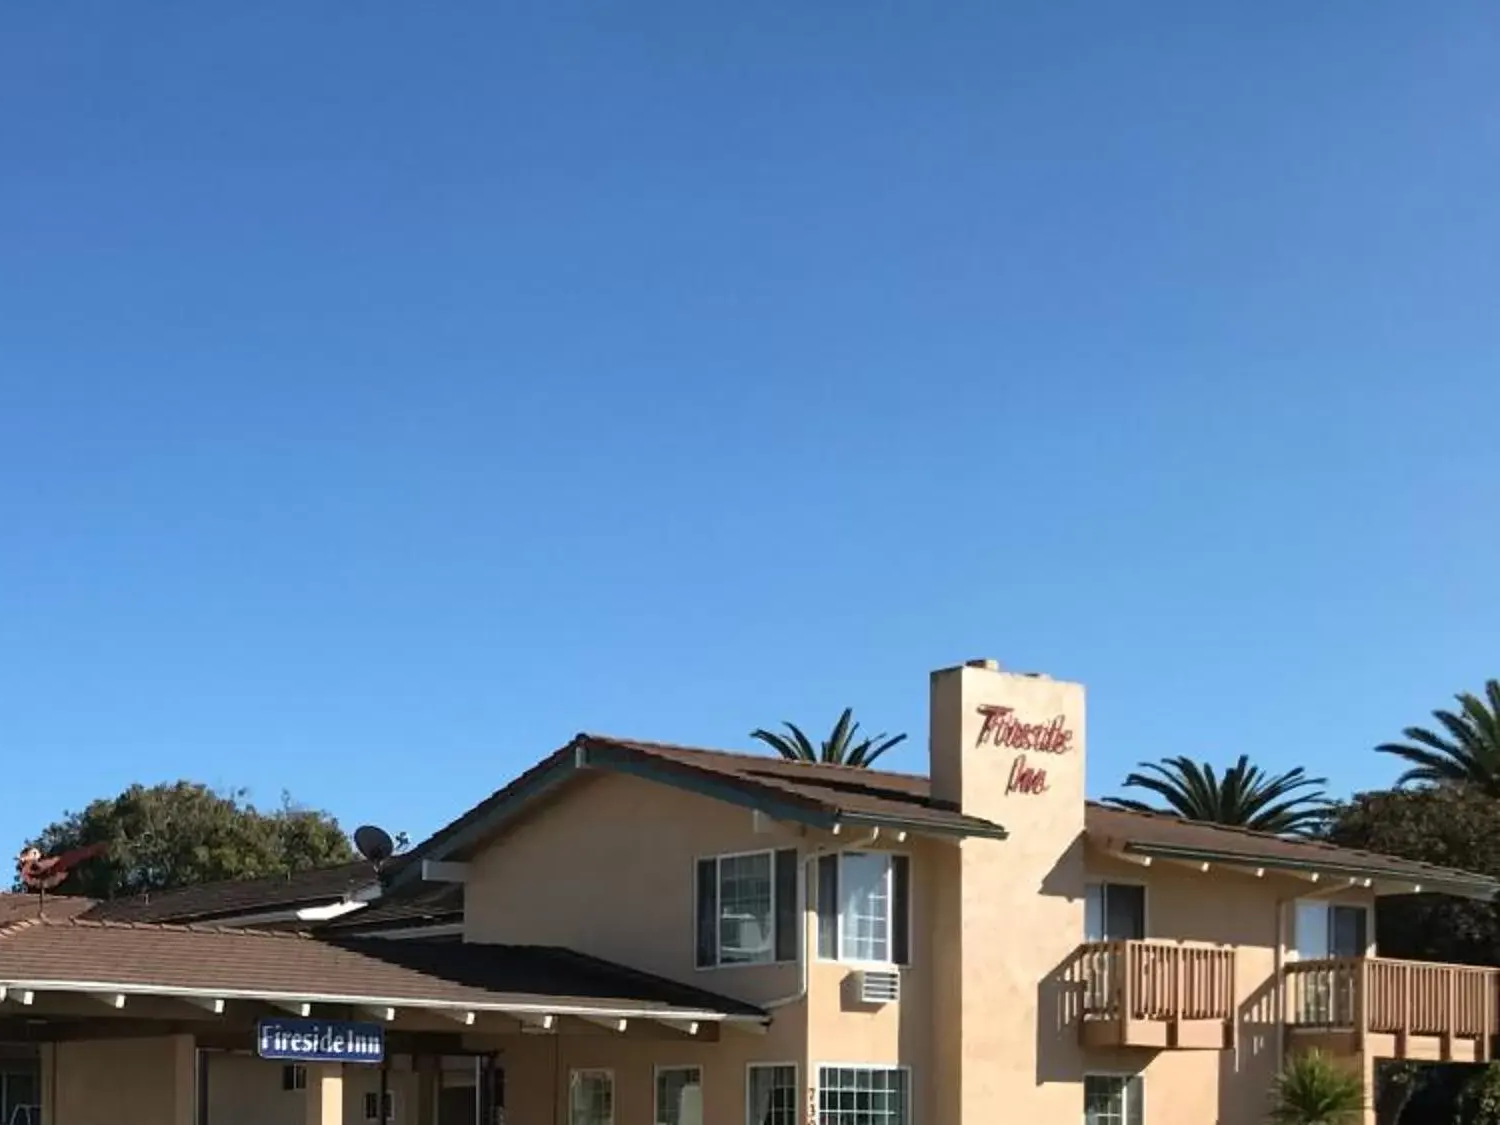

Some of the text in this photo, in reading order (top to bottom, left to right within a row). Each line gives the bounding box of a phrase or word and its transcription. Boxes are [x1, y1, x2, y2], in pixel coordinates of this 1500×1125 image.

[976, 705, 1073, 754] Fireside
[1005, 754, 1050, 797] Inn
[262, 1024, 380, 1054] Fireside Inn
